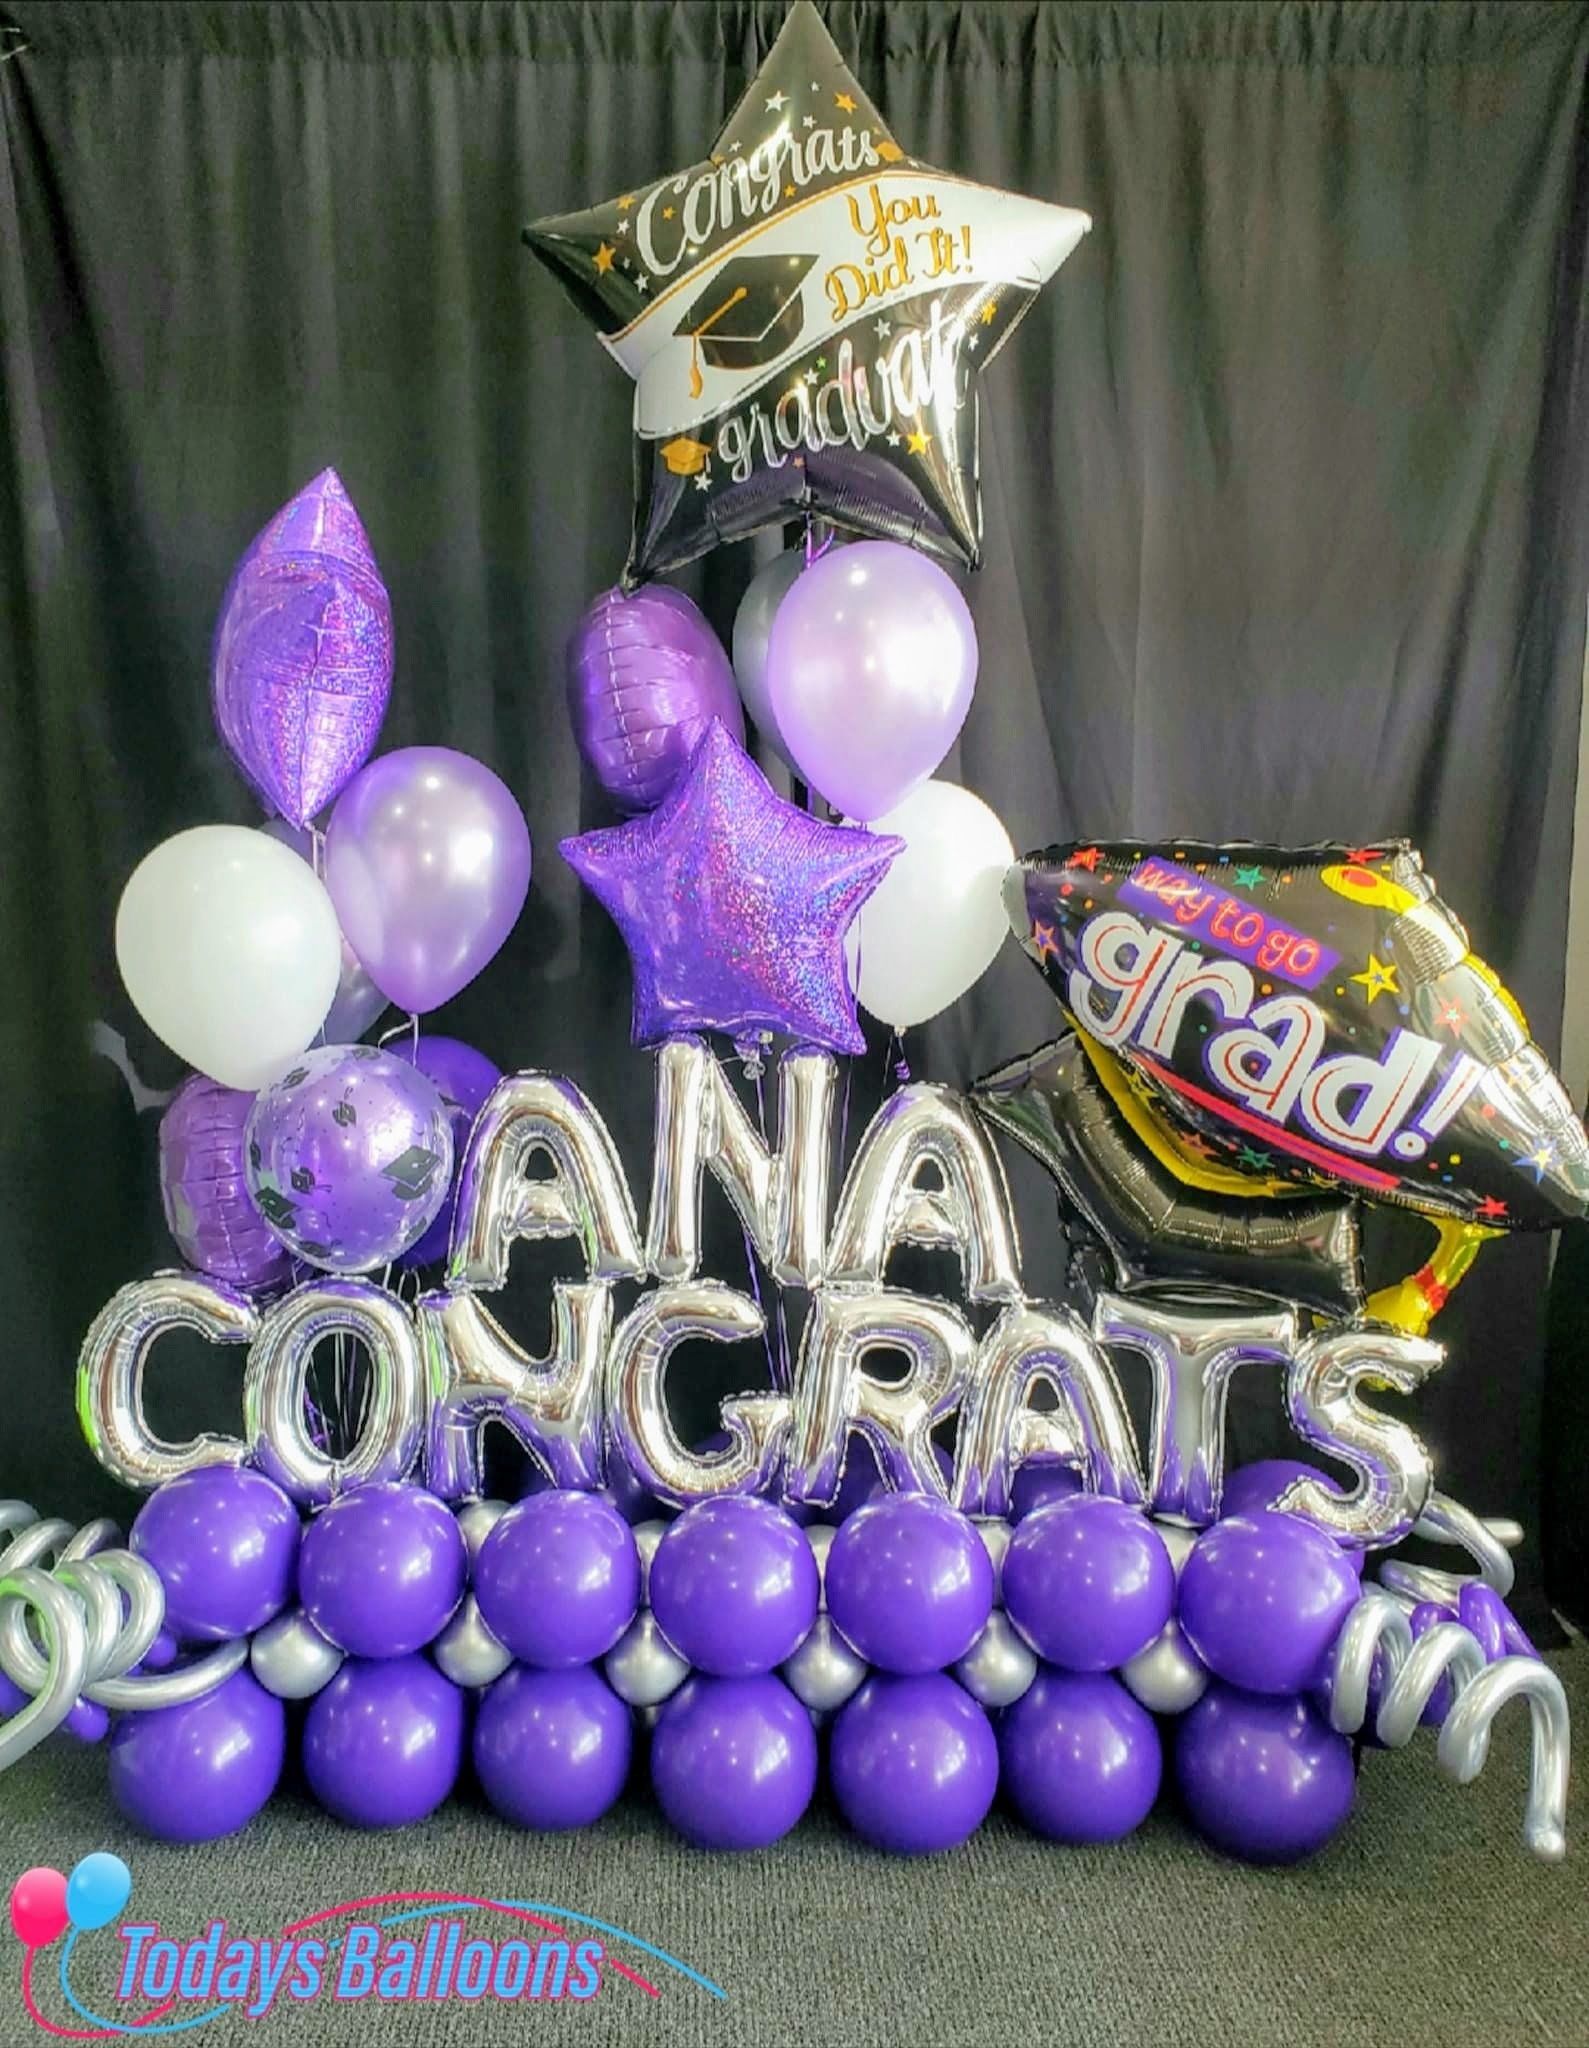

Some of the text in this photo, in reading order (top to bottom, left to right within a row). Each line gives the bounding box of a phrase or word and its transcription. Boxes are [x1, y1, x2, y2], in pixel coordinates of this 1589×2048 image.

[636, 127, 879, 276] Congrats
[825, 224, 973, 323] Did It!
[845, 183, 942, 257] You
[718, 299, 966, 483] graduat
[1130, 862, 1321, 977] way to go
[1068, 910, 1487, 1157] grad!
[445, 1032, 1024, 1301] ANA
[76, 1268, 1449, 1551] CONGRATS
